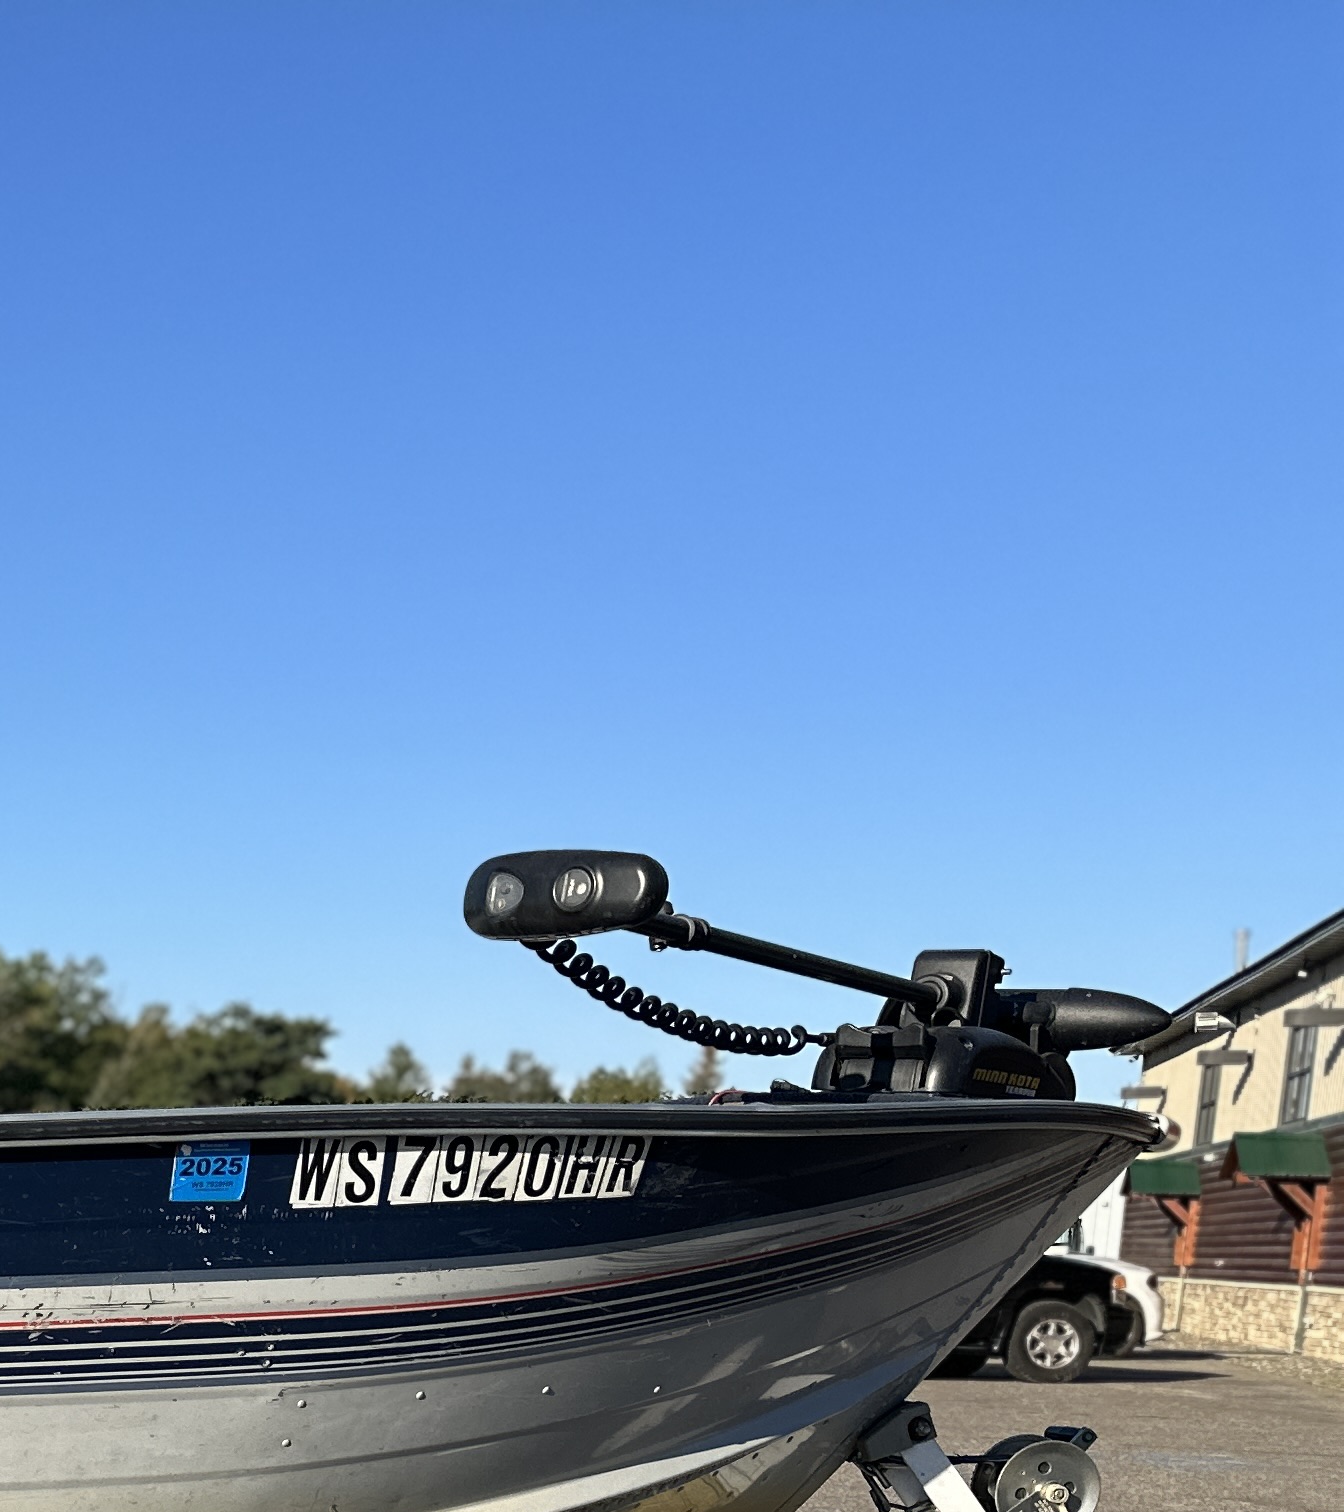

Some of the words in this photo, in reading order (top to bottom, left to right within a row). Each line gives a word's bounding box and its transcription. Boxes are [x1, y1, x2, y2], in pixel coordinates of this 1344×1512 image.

[973, 1068, 1008, 1084] MINN
[1008, 1073, 1041, 1090] KOTA
[178, 1157, 244, 1176] 2025
[298, 1136, 378, 1205] WS
